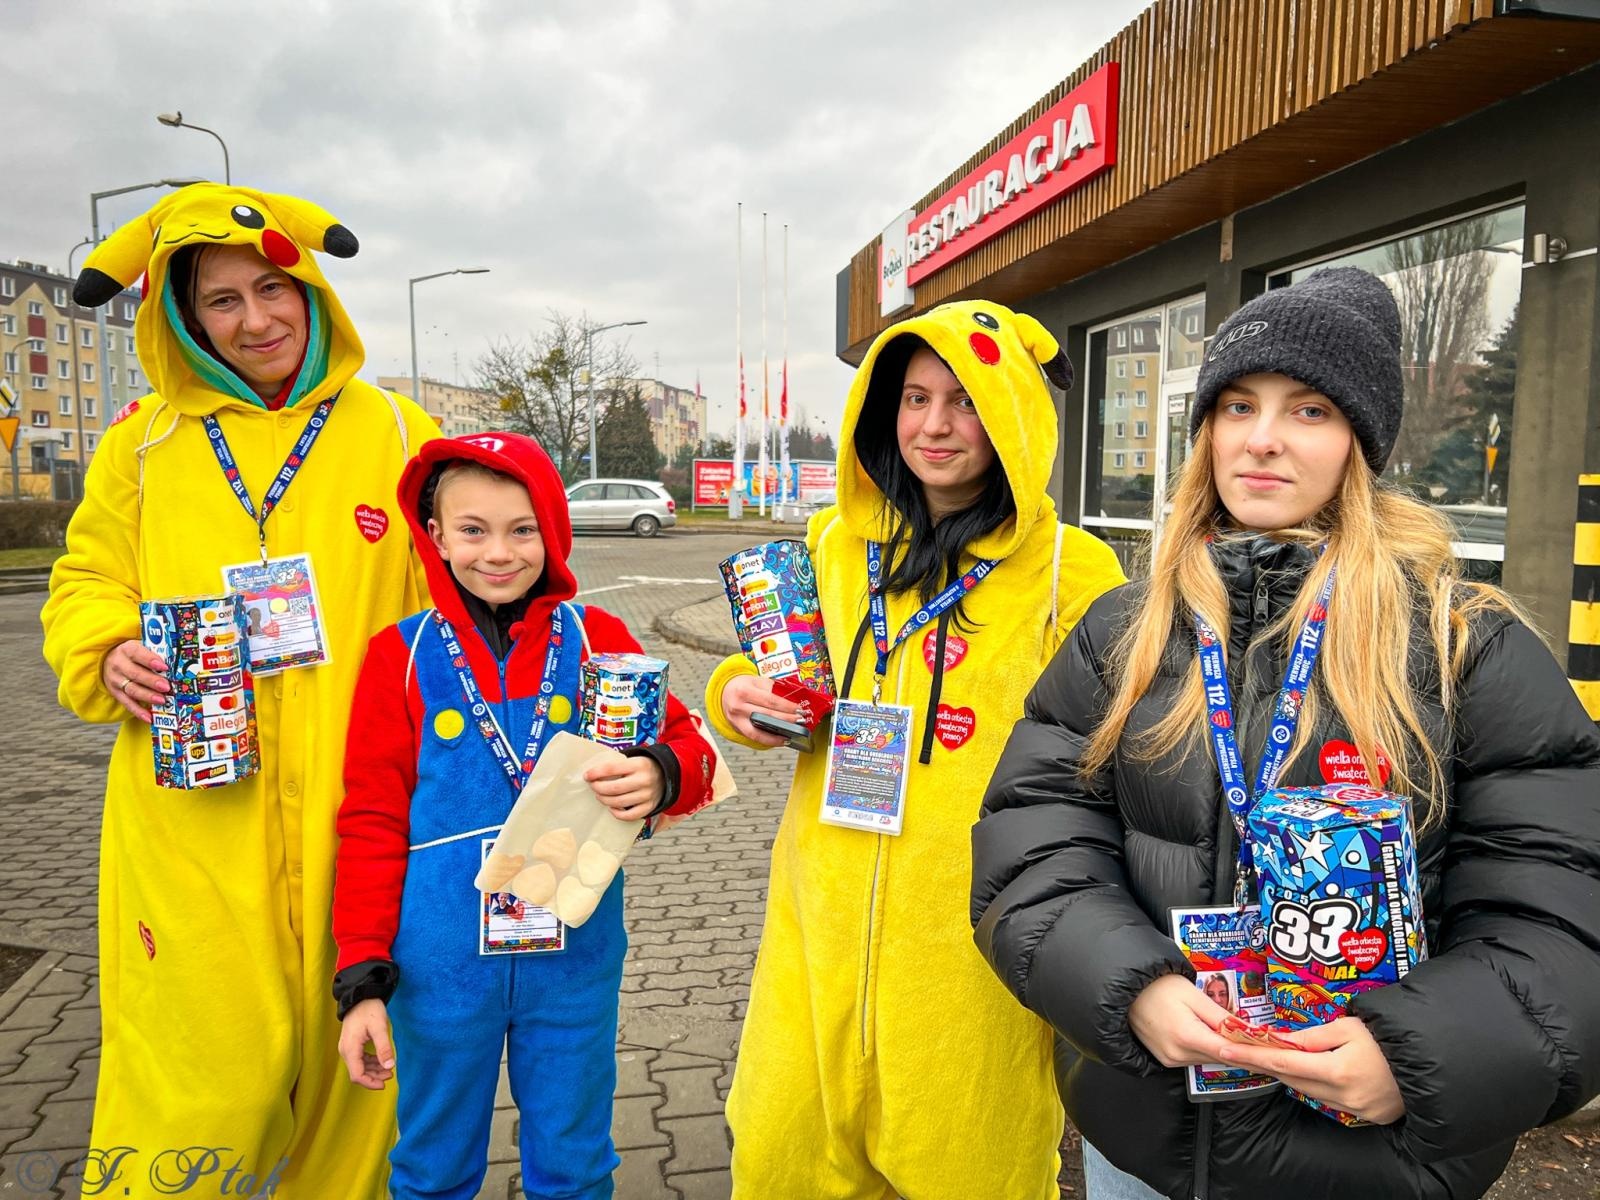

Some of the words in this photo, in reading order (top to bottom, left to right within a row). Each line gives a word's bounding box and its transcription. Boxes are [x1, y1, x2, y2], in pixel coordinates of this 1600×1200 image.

[907, 103, 1095, 268] RESTAURACJA
[280, 467, 294, 481] 112
[233, 479, 244, 495] 112
[742, 558, 759, 570] onet
[974, 562, 990, 578] 112
[277, 568, 296, 584] 33
[746, 598, 774, 613] mBank
[149, 626, 161, 636] tvn
[553, 620, 562, 633] 112
[750, 619, 778, 634] PLAY
[873, 620, 885, 636] 112
[1201, 624, 1216, 640] 33
[1300, 626, 1320, 649] 112
[446, 640, 460, 656] 112
[207, 652, 238, 666] mBank
[760, 658, 792, 675] allegro
[1203, 656, 1212, 676] POMOC
[1211, 652, 1222, 679] PIERWSZA
[1289, 653, 1304, 684] PIERWSZA
[1298, 660, 1311, 682] POMOC
[208, 674, 239, 687] PLAY
[1208, 684, 1225, 705] 112
[1284, 694, 1296, 717] 33
[156, 716, 176, 728] max
[210, 715, 244, 731] allegro
[600, 725, 630, 733] mBank
[856, 727, 880, 744] 33
[942, 732, 962, 744] pomocy
[191, 749, 204, 759] ups
[525, 742, 538, 757] 112
[1325, 750, 1350, 764] wielka
[503, 761, 516, 776] 112
[1382, 846, 1397, 879] GRAMY
[1276, 888, 1308, 905] 2025
[1386, 881, 1400, 900] DLA
[1272, 902, 1357, 962] 33
[1389, 901, 1406, 952] ONKOLOGII
[1342, 937, 1359, 946] wielka
[1355, 955, 1375, 964] pomocy
[1311, 961, 1358, 980] FINAŁ
